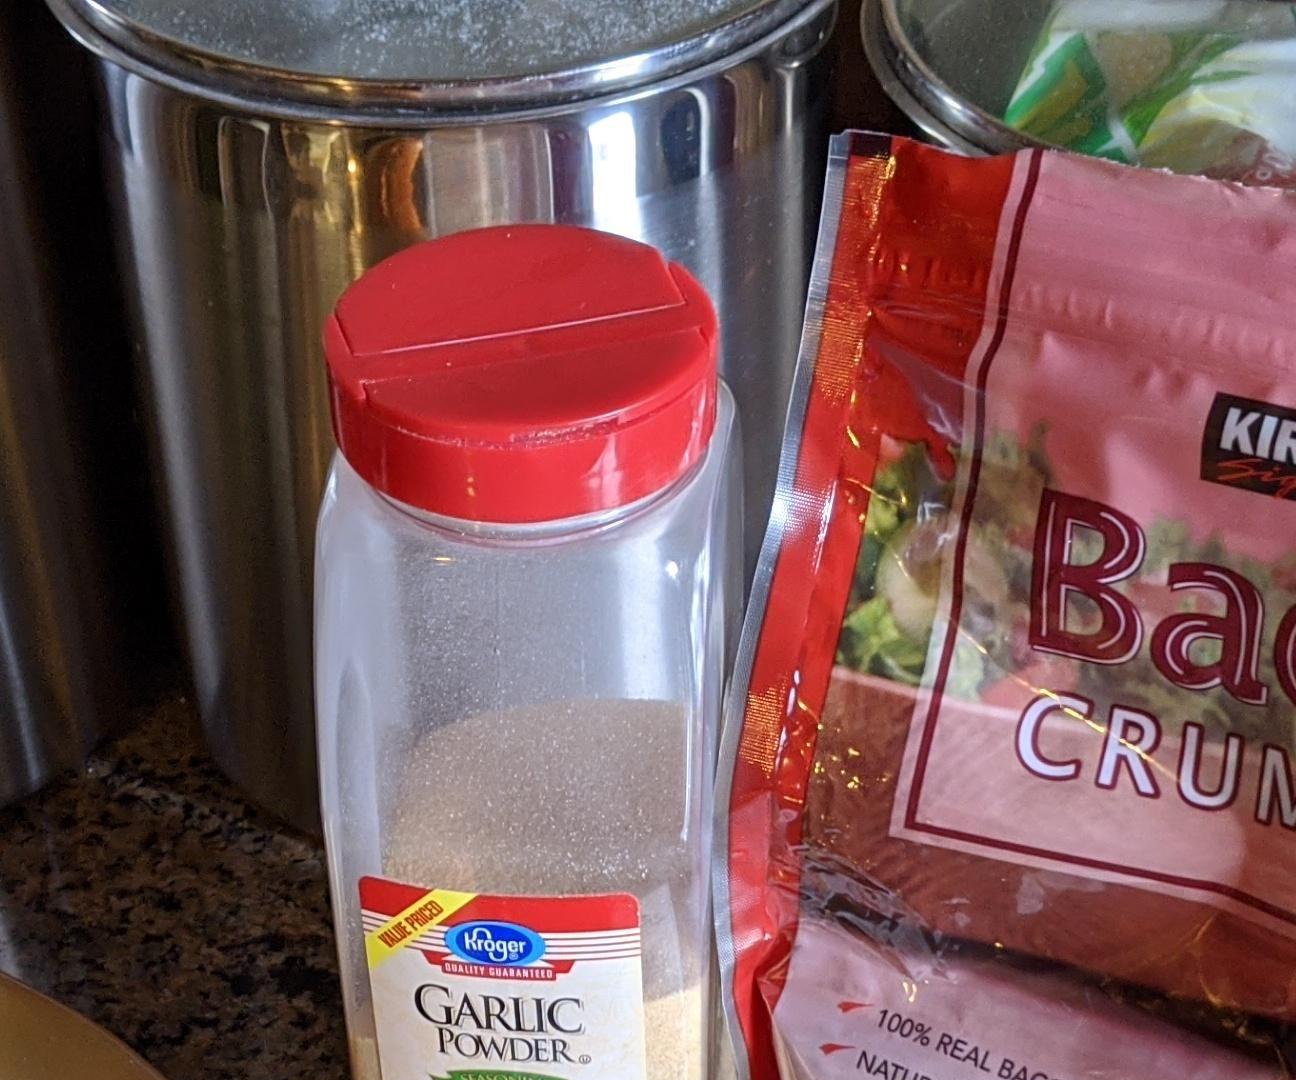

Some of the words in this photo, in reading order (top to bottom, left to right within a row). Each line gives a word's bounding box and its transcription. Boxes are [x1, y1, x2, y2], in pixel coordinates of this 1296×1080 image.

[1029, 487, 1296, 706] Ba
[377, 919, 408, 949] VALUE
[406, 899, 444, 932] PRICED
[464, 927, 527, 961] Kroger
[444, 961, 485, 976] QUALITY
[488, 966, 554, 979] GUARANTEED
[414, 984, 583, 1034] GARLIC
[437, 1027, 575, 1064] POWDER
[877, 1009, 932, 1047] 100%
[936, 1033, 991, 1073] REAL
